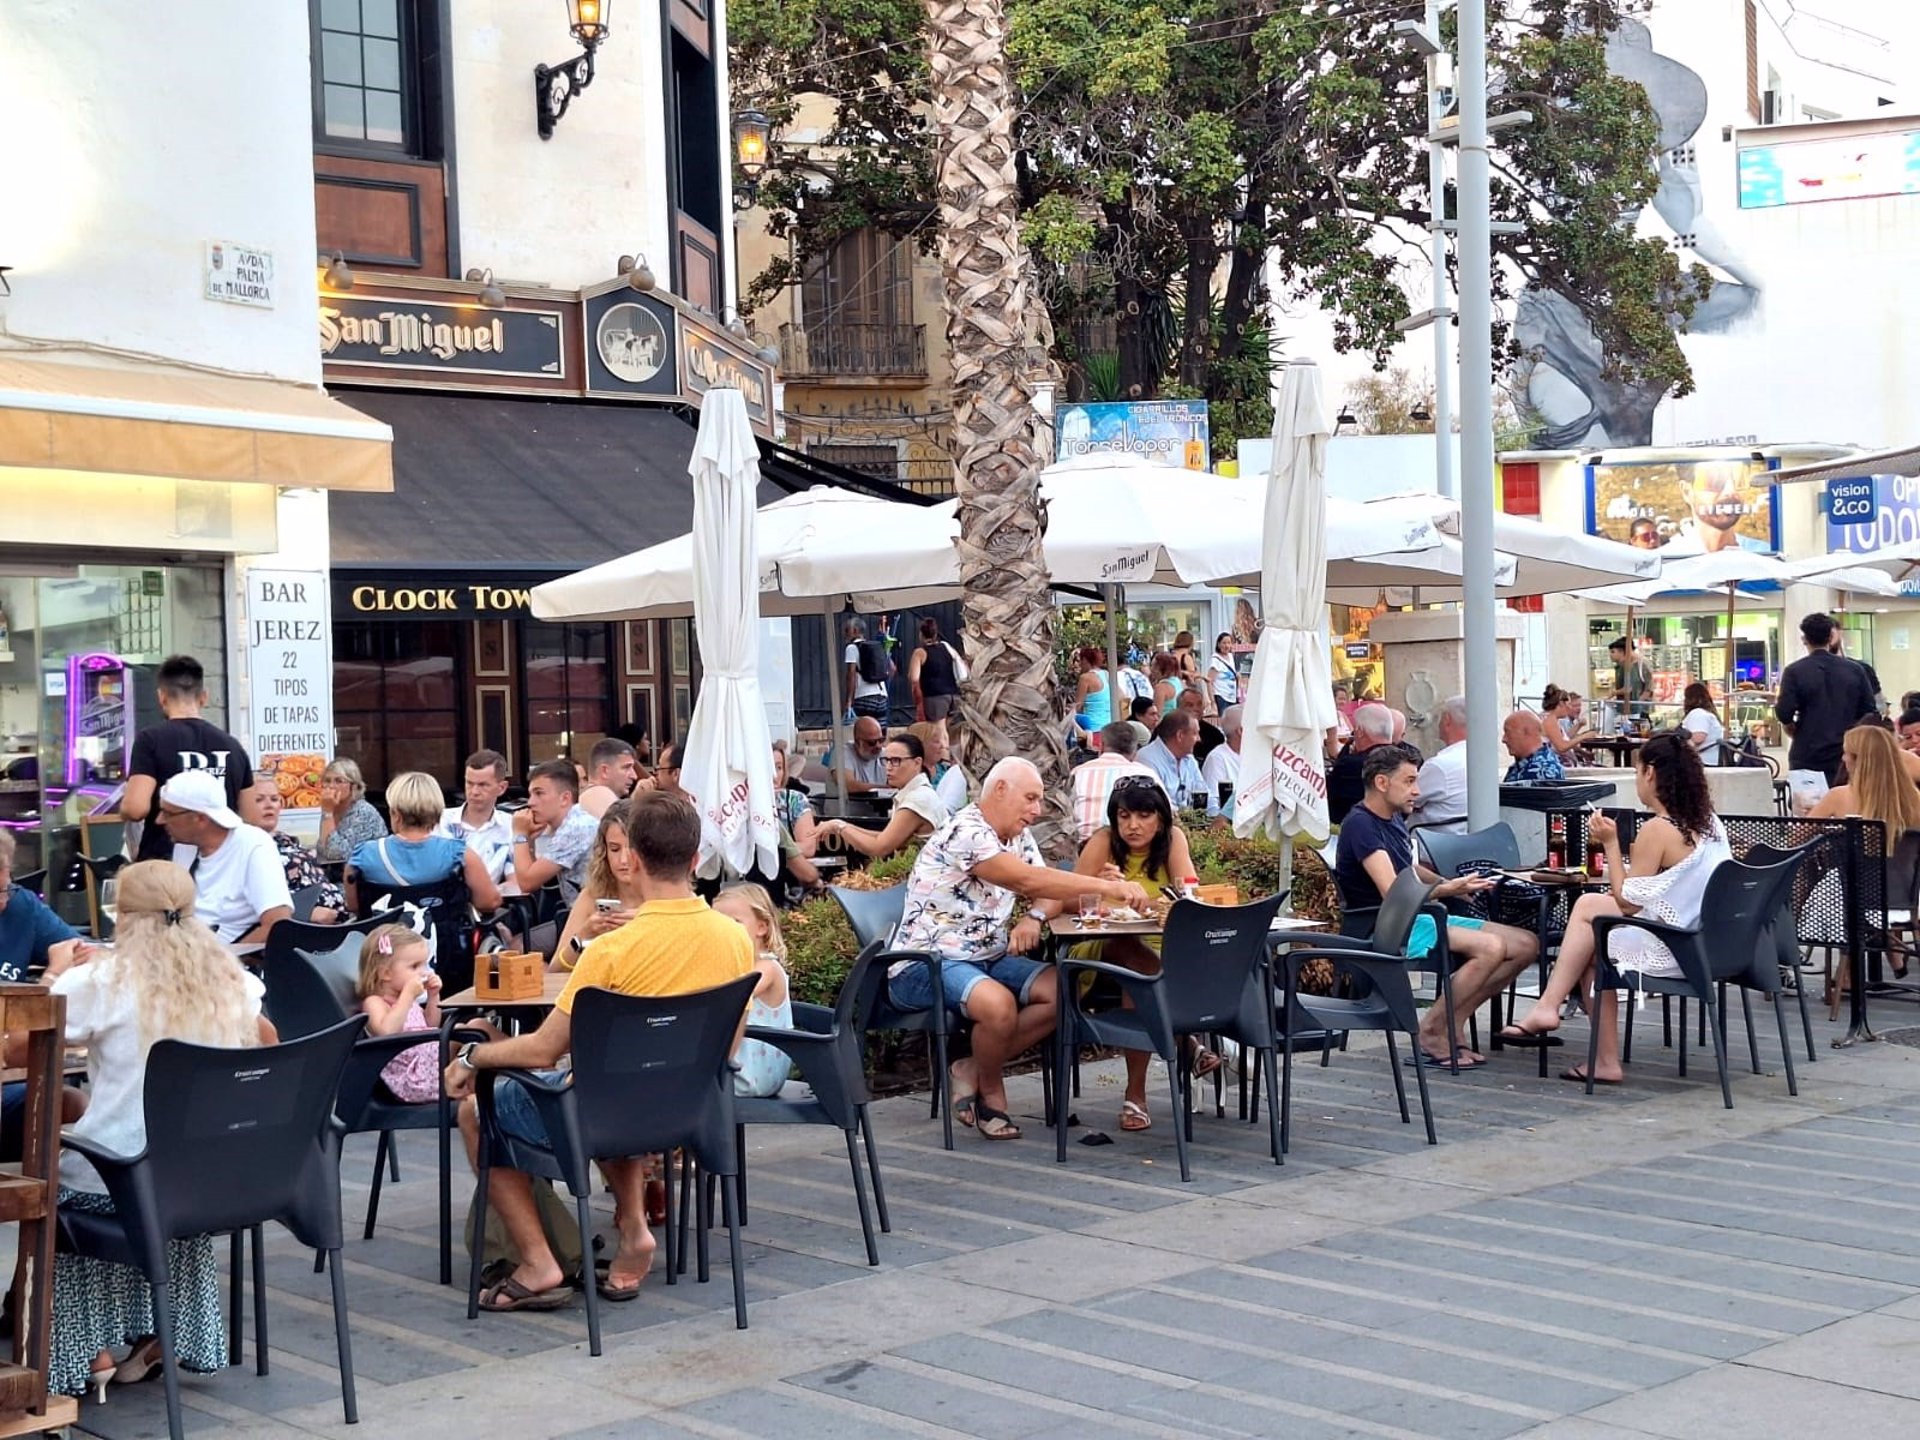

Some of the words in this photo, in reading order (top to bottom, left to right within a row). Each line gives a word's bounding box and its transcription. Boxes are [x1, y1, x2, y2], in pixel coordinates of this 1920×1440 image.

[236, 268, 264, 285] PALMA
[226, 281, 271, 300] MALLORCA
[1831, 483, 1870, 497] vision
[1832, 499, 1870, 516] &co
[261, 582, 307, 603] BAR
[352, 586, 458, 611] CLOCK
[252, 620, 322, 648] JEREZ
[282, 651, 298, 669] 22
[274, 678, 308, 696] TIPOS
[264, 707, 279, 724] DE
[282, 706, 319, 724] TAPAS
[258, 733, 326, 752] DIFERENTES
[1272, 767, 1317, 810] SPECIAL
